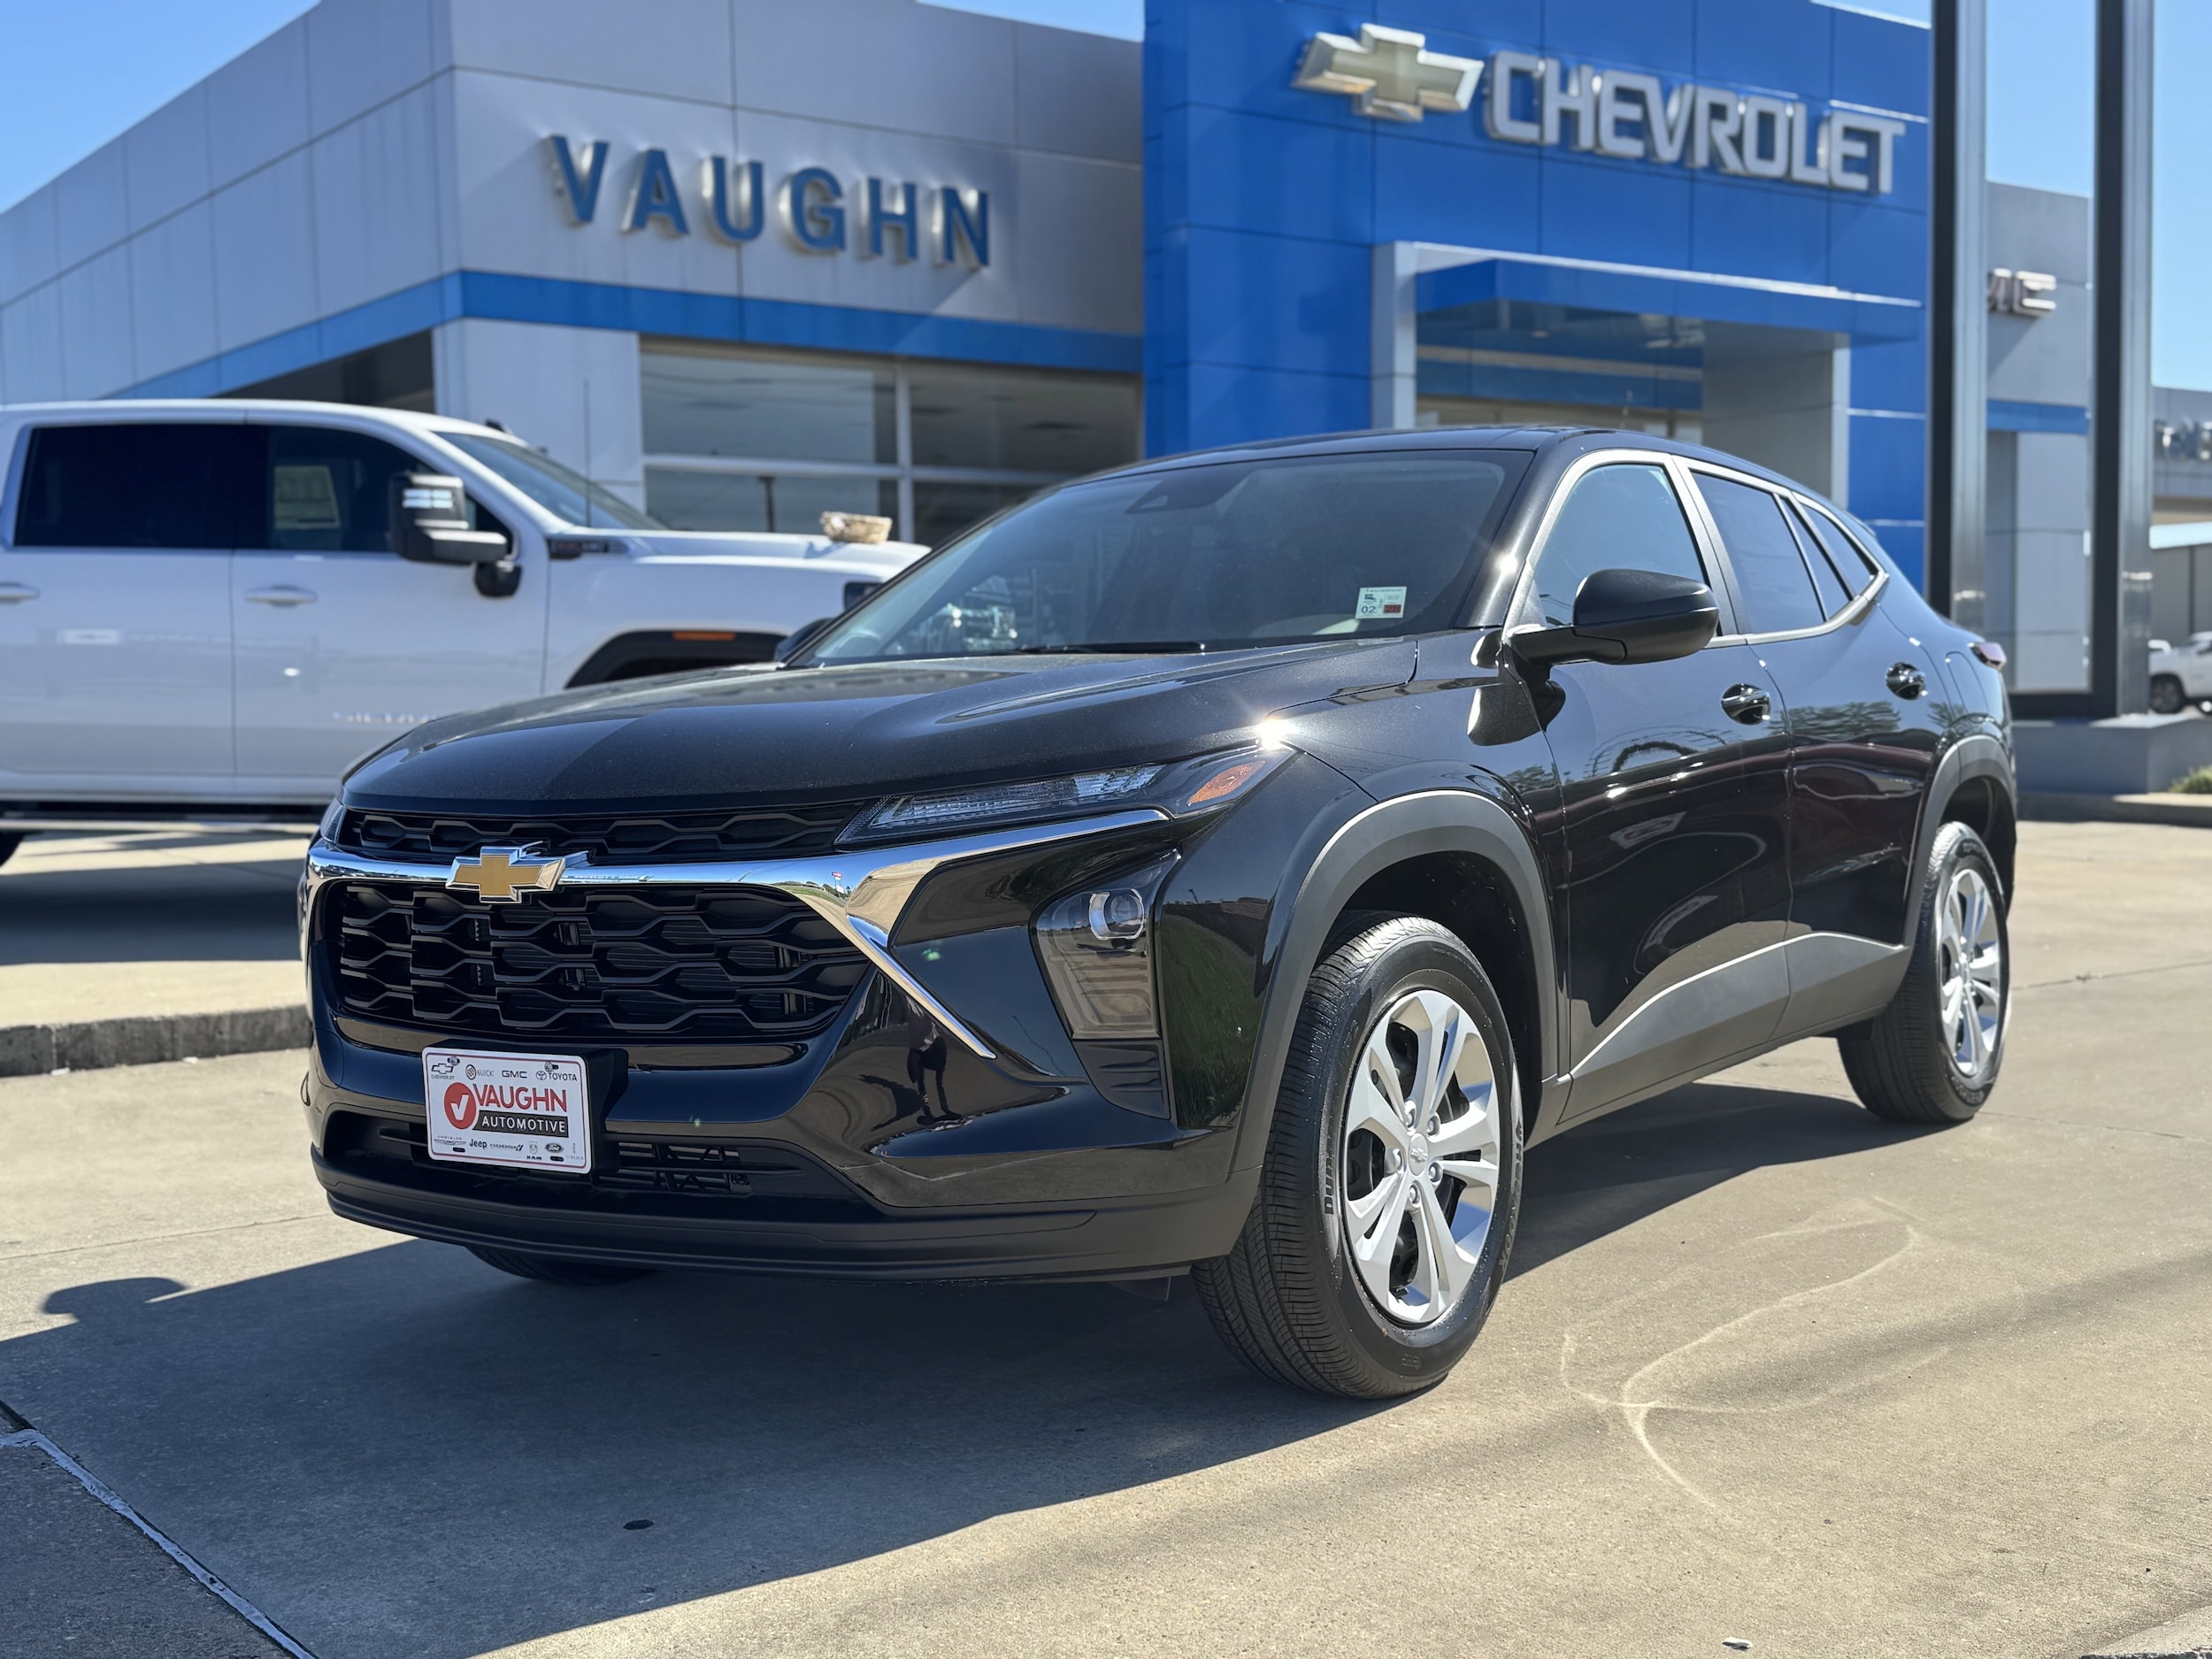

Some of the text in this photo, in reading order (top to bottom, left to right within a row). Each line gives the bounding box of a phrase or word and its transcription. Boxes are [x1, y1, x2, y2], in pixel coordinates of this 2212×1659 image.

[1486, 50, 1906, 196] CHEVROLET
[542, 134, 990, 266] VAUGHN
[1361, 605, 1376, 614] 02
[502, 1070, 528, 1079] GMC
[548, 1071, 578, 1082] TOYOTA
[472, 1083, 567, 1113] VAUGHN
[481, 1116, 566, 1133] AUTOMOTIVE
[469, 1139, 488, 1149] Jeep
